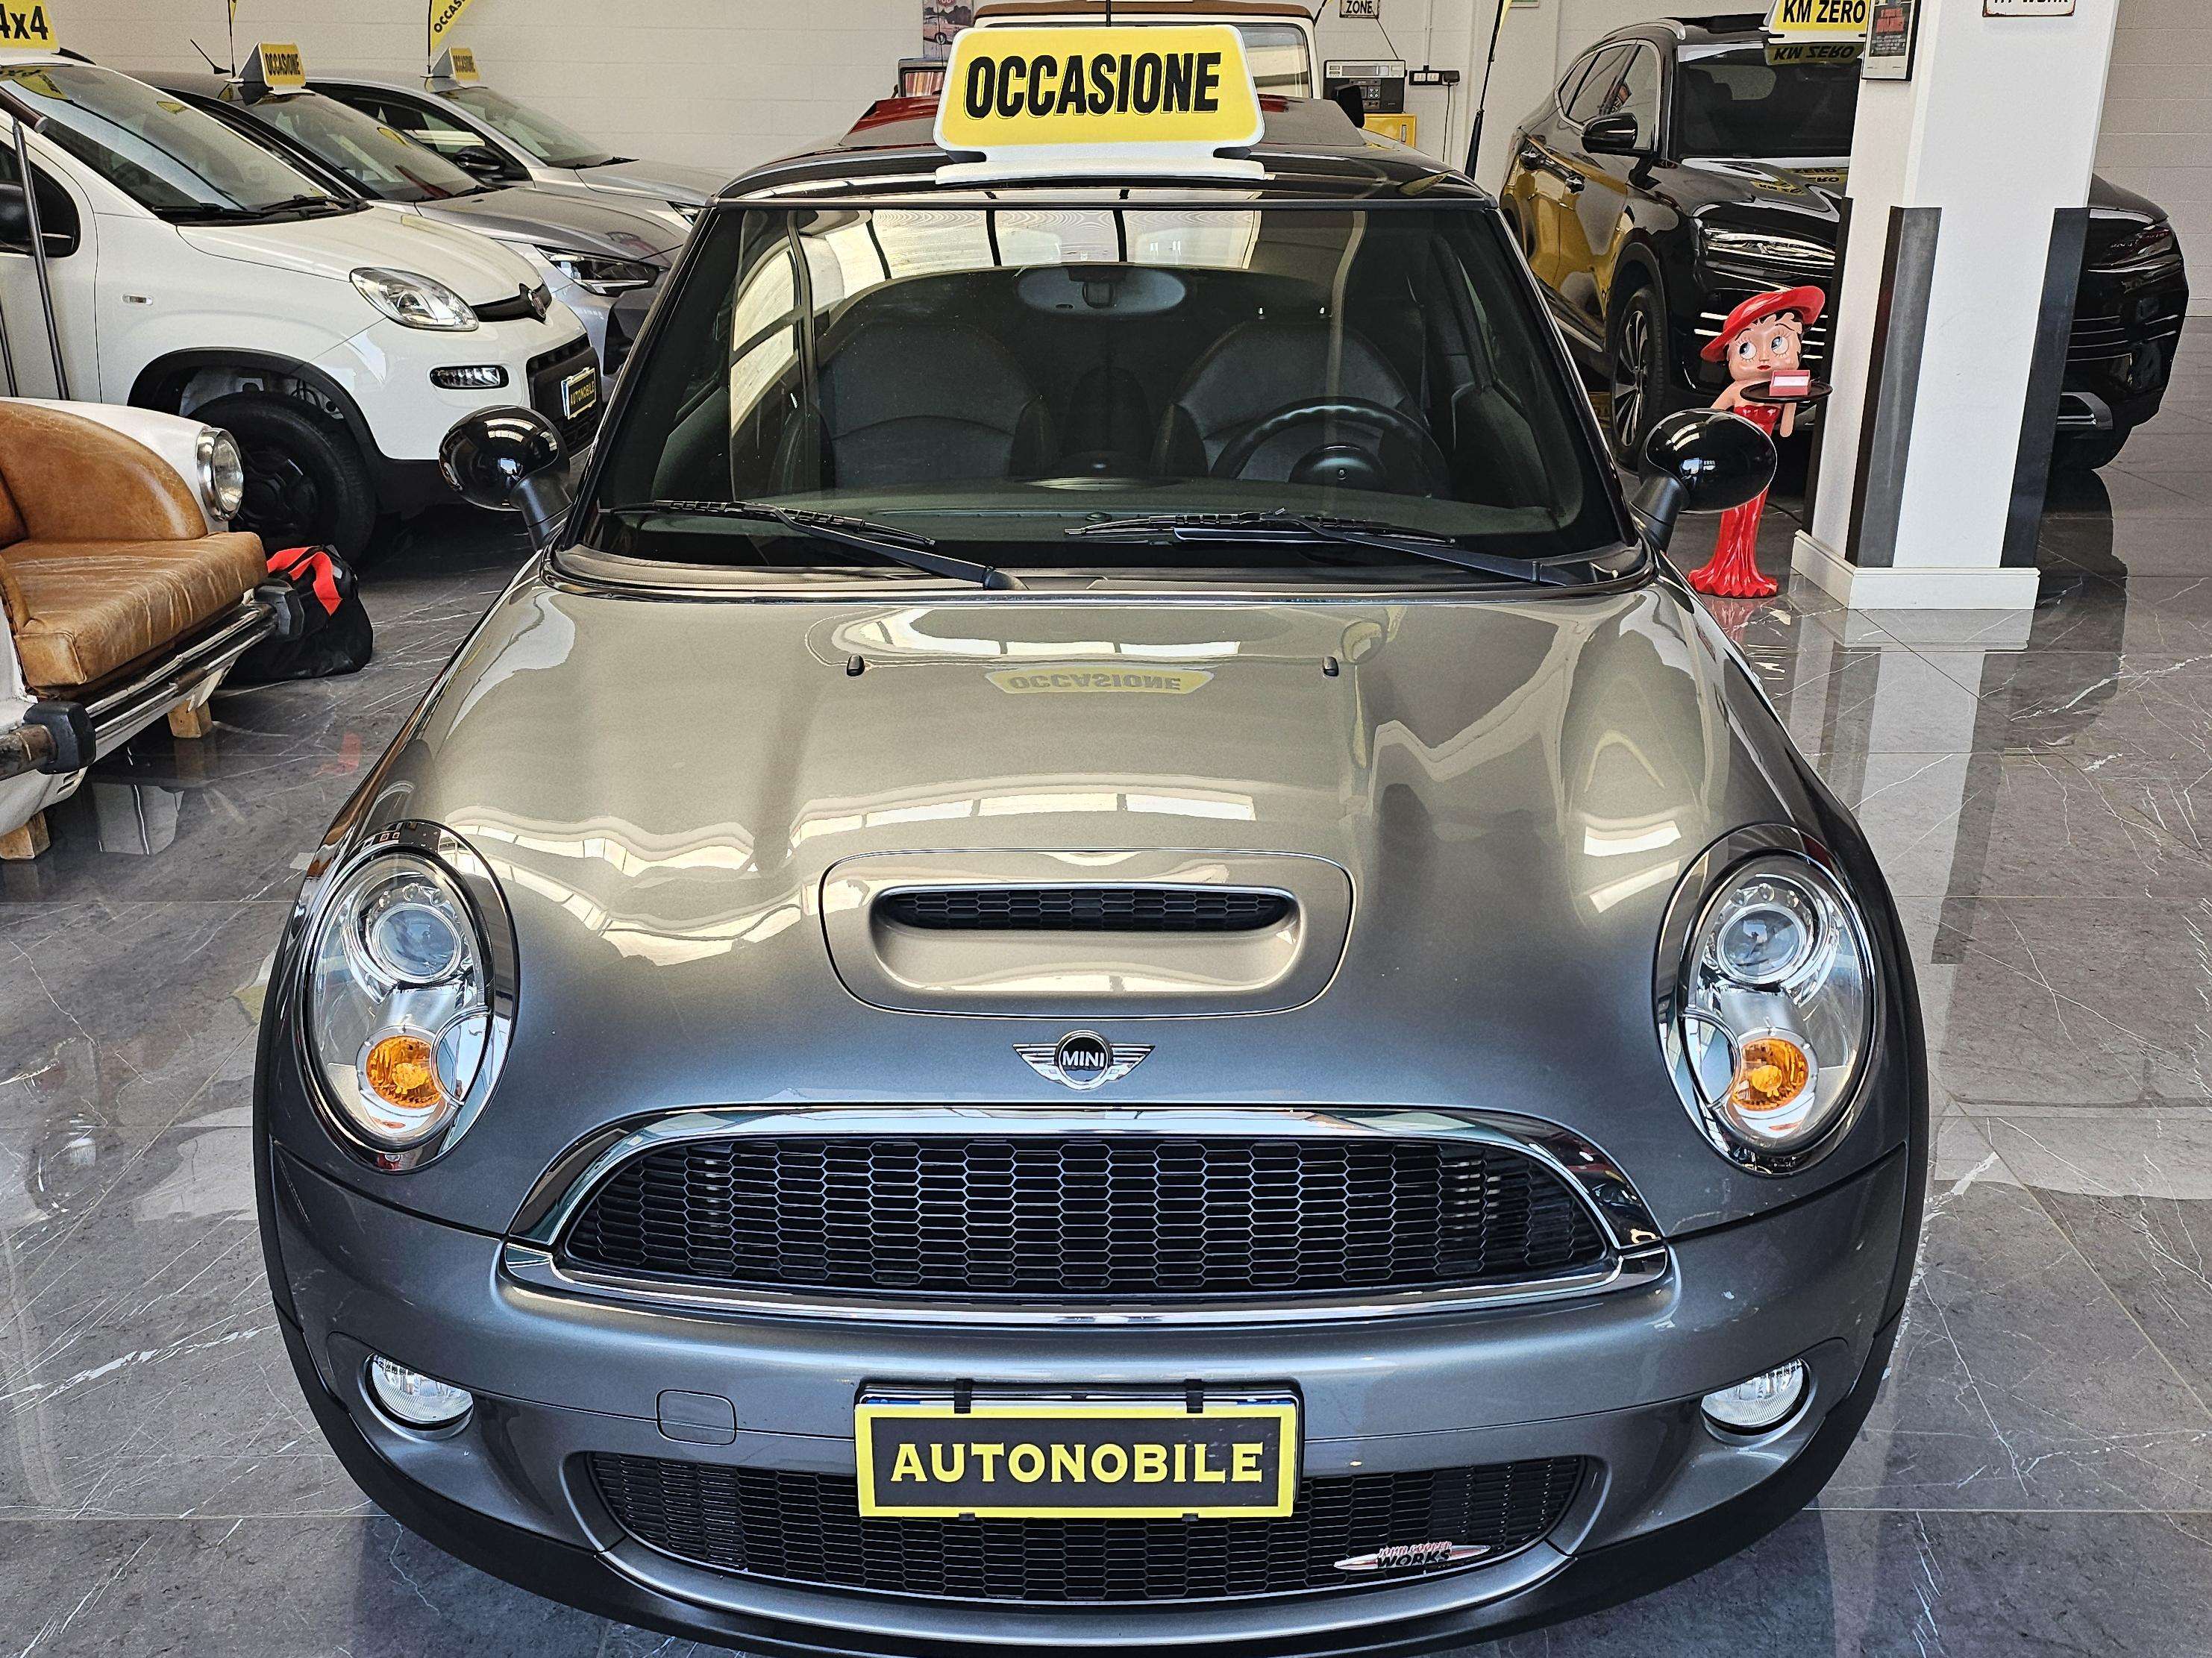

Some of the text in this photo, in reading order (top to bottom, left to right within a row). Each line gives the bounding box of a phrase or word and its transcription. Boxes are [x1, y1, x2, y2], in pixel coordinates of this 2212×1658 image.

[433, 0, 466, 33] OCCAS
[1346, 0, 1373, 13] ZONE
[1782, 0, 1812, 23] KM
[1816, 0, 1865, 23] ZERO
[0, 3, 48, 40] 4x4
[963, 51, 1222, 120] OCCASIONE
[1062, 1050, 1105, 1067] MINI
[891, 1442, 1264, 1483] AUTONOBILE
[1377, 1548, 1451, 1567] WORKS
